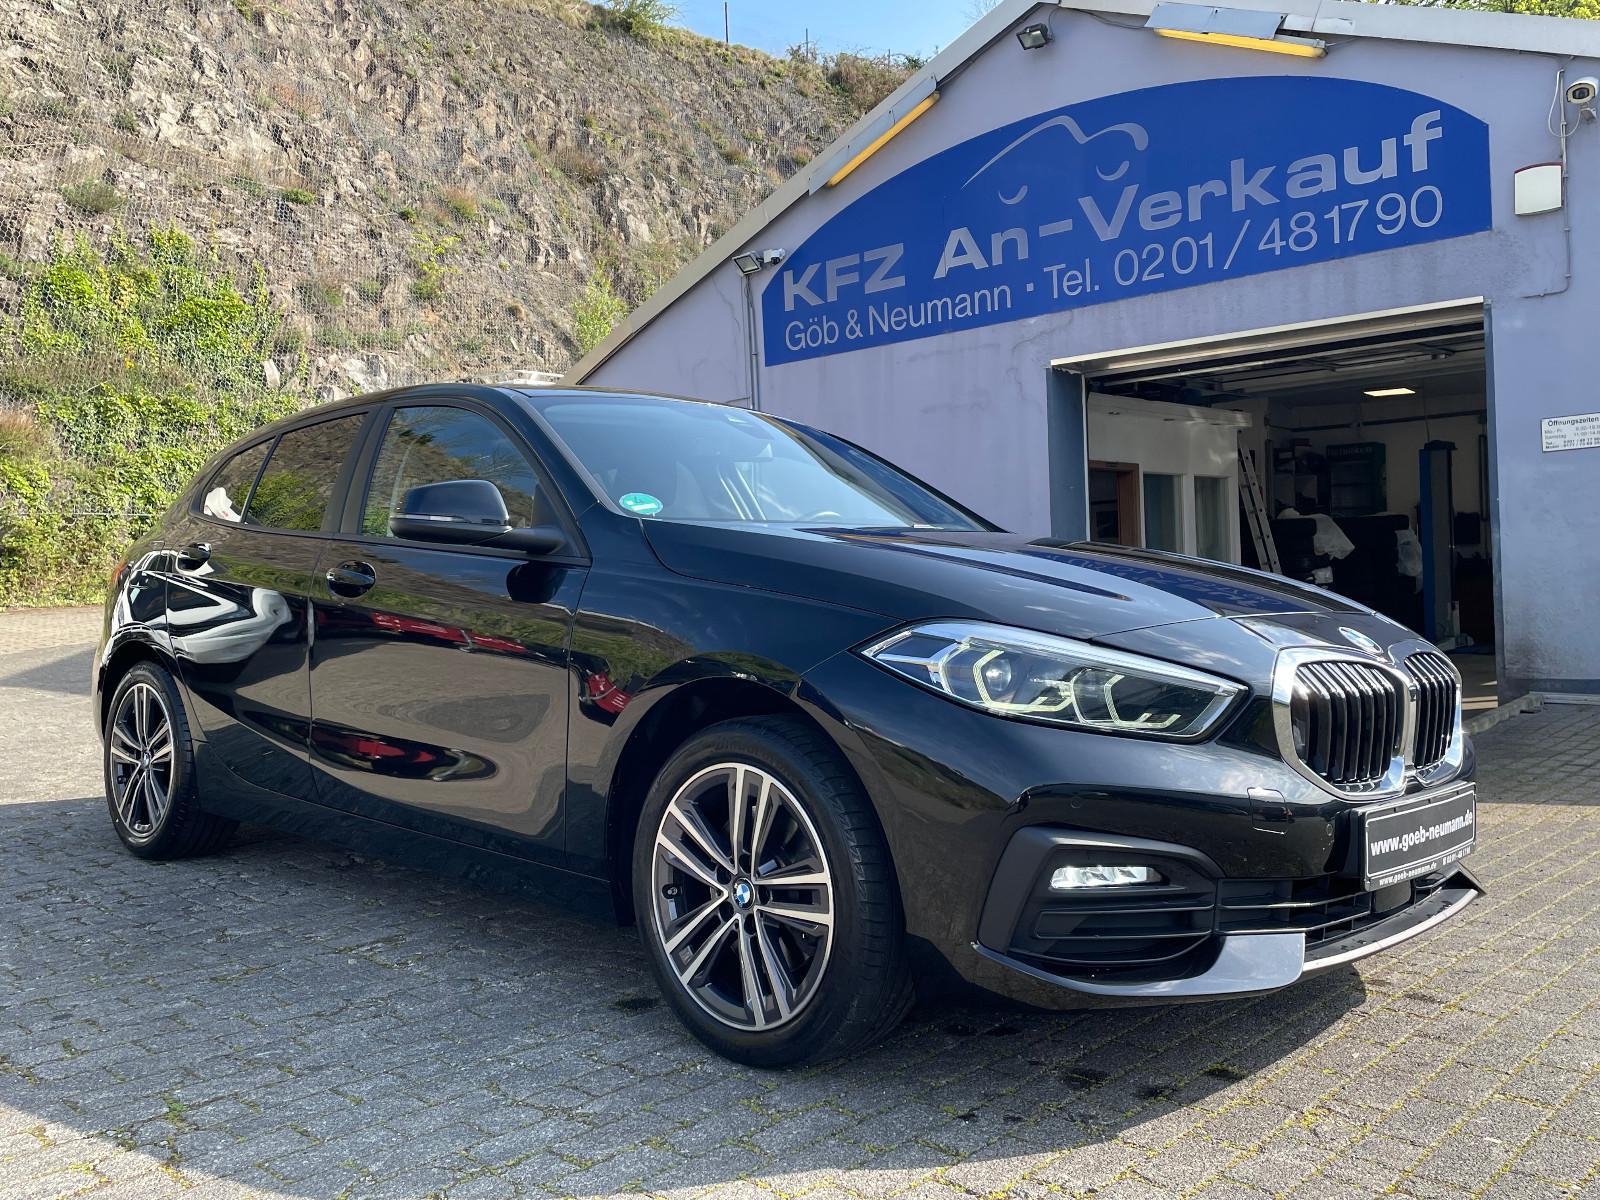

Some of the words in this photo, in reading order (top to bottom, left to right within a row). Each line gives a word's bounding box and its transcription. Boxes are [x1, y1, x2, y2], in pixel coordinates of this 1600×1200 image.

[783, 242, 906, 312] KFZ
[932, 109, 1443, 280] An-Verkauf
[784, 314, 839, 352] Göb
[844, 308, 864, 341] &
[867, 283, 1012, 337] Neumann
[1042, 257, 1100, 300] Tel.
[1370, 809, 1473, 857] www.goeb-neumann.de
[1379, 862, 1437, 886] www.goeb-neumann.de
